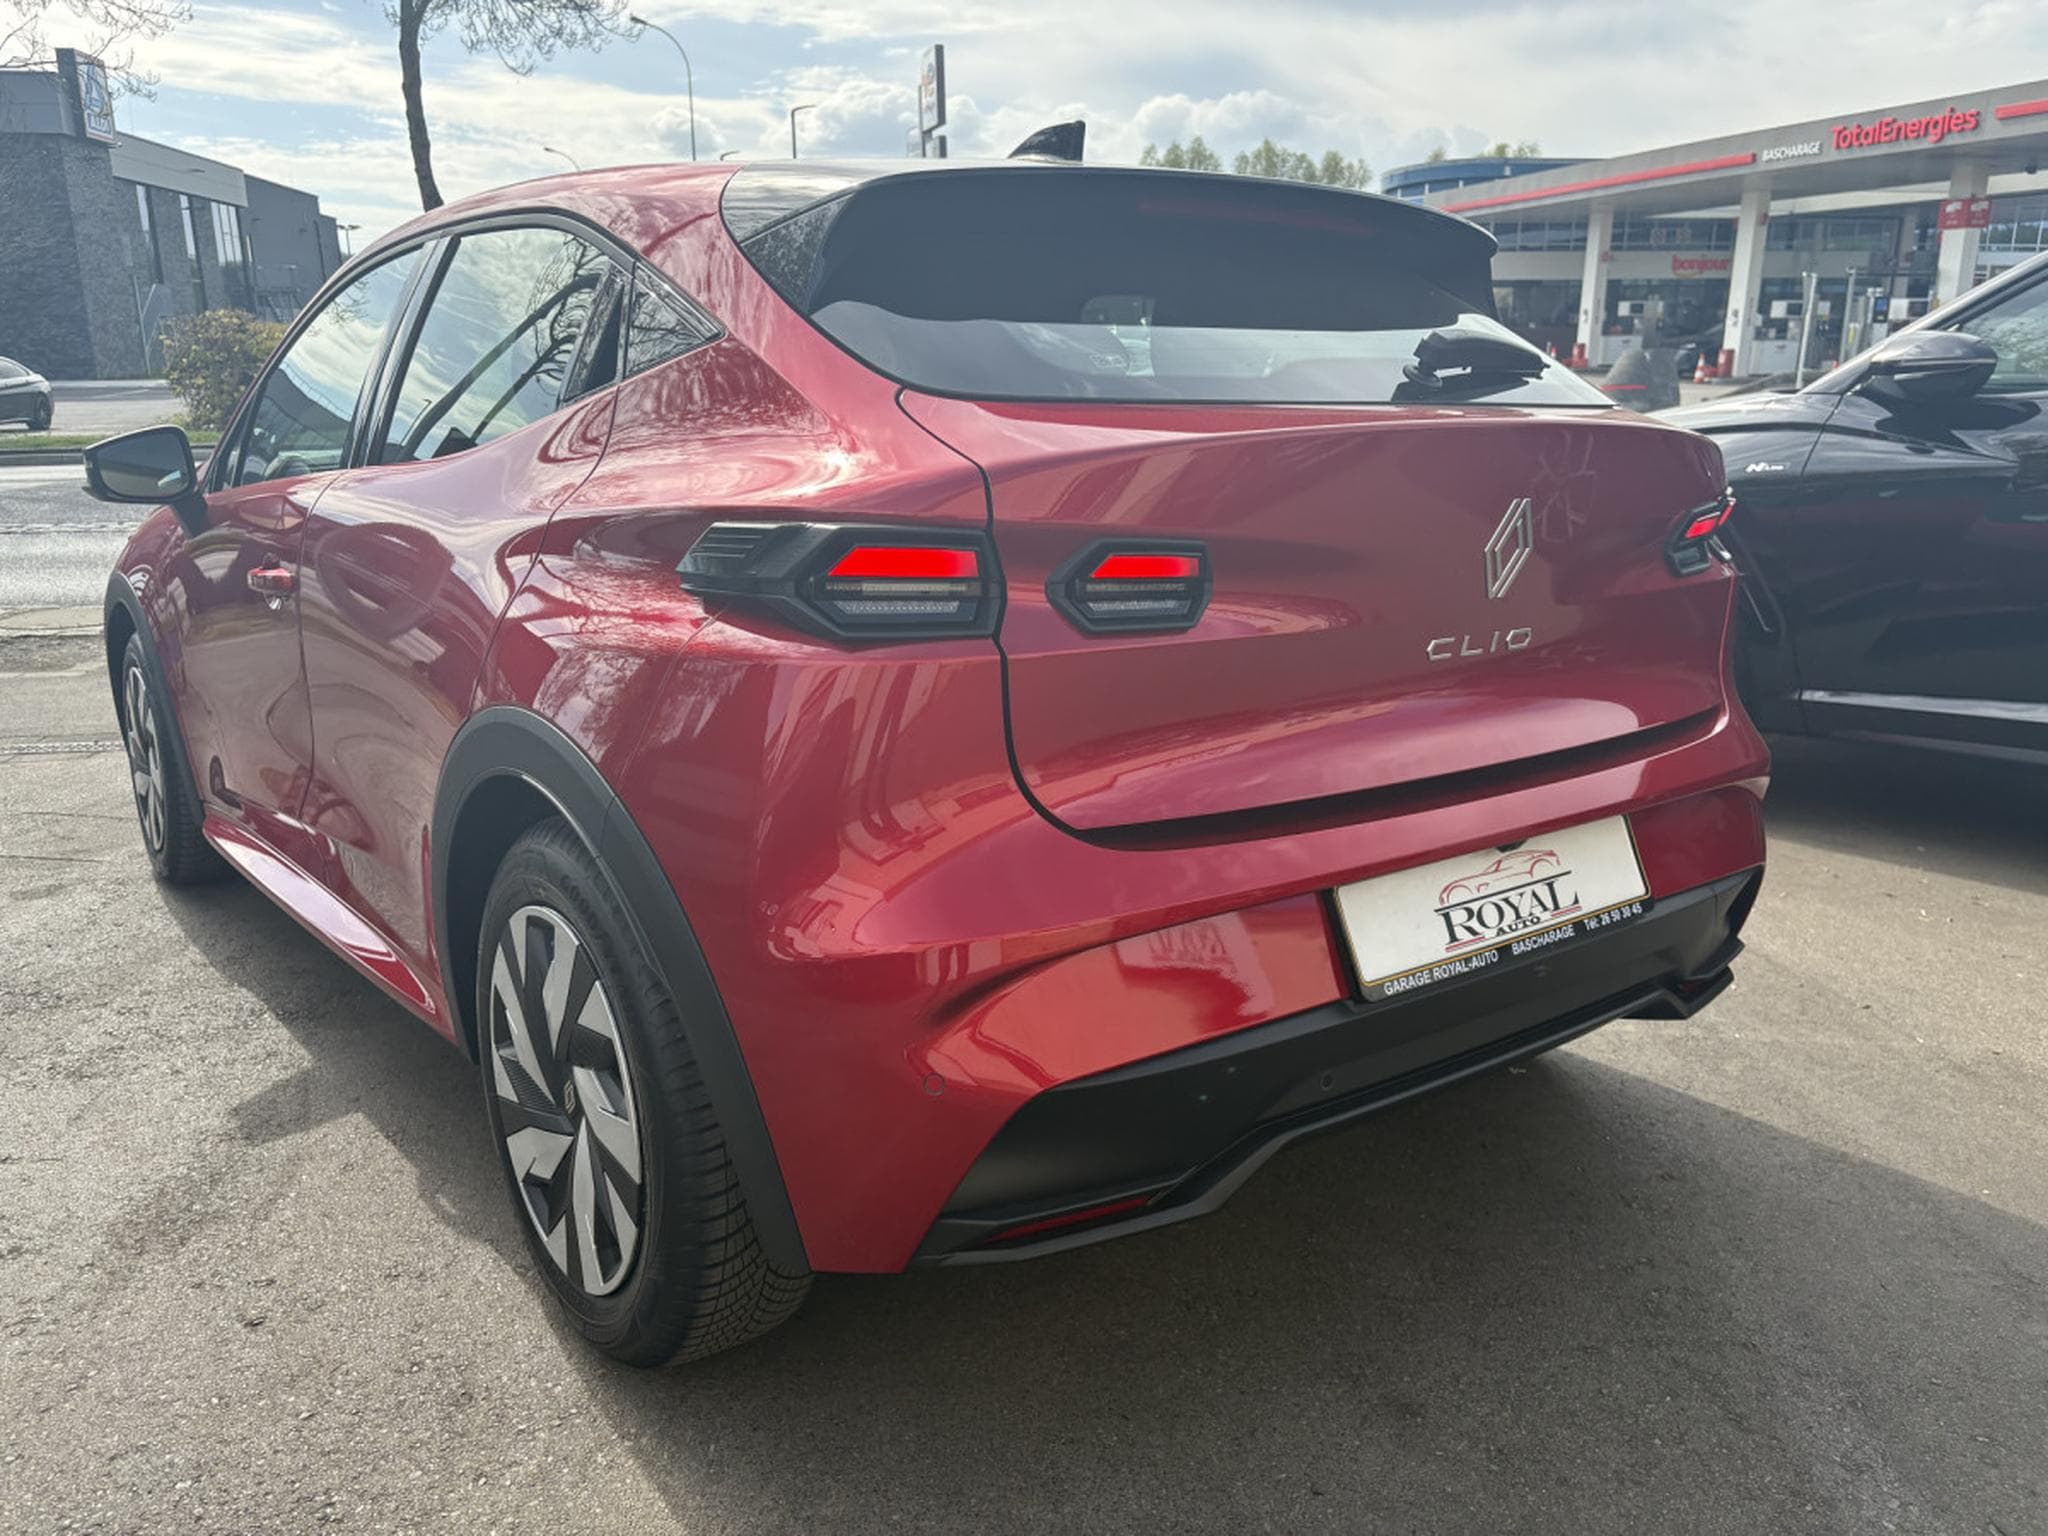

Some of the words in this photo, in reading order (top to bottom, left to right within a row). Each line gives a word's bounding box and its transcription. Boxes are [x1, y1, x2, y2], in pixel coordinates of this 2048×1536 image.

[1762, 141, 1822, 162] BASCHARAGE
[1830, 105, 1979, 151] TotalEnergies
[1426, 627, 1532, 661] CLIO
[1438, 879, 1580, 945] ROYAL
[1495, 915, 1541, 938] AUTO
[1383, 969, 1433, 995] GARAGE
[1433, 949, 1499, 980] ROYAL-AUTO
[1511, 924, 1576, 956] BASCHARAGE
